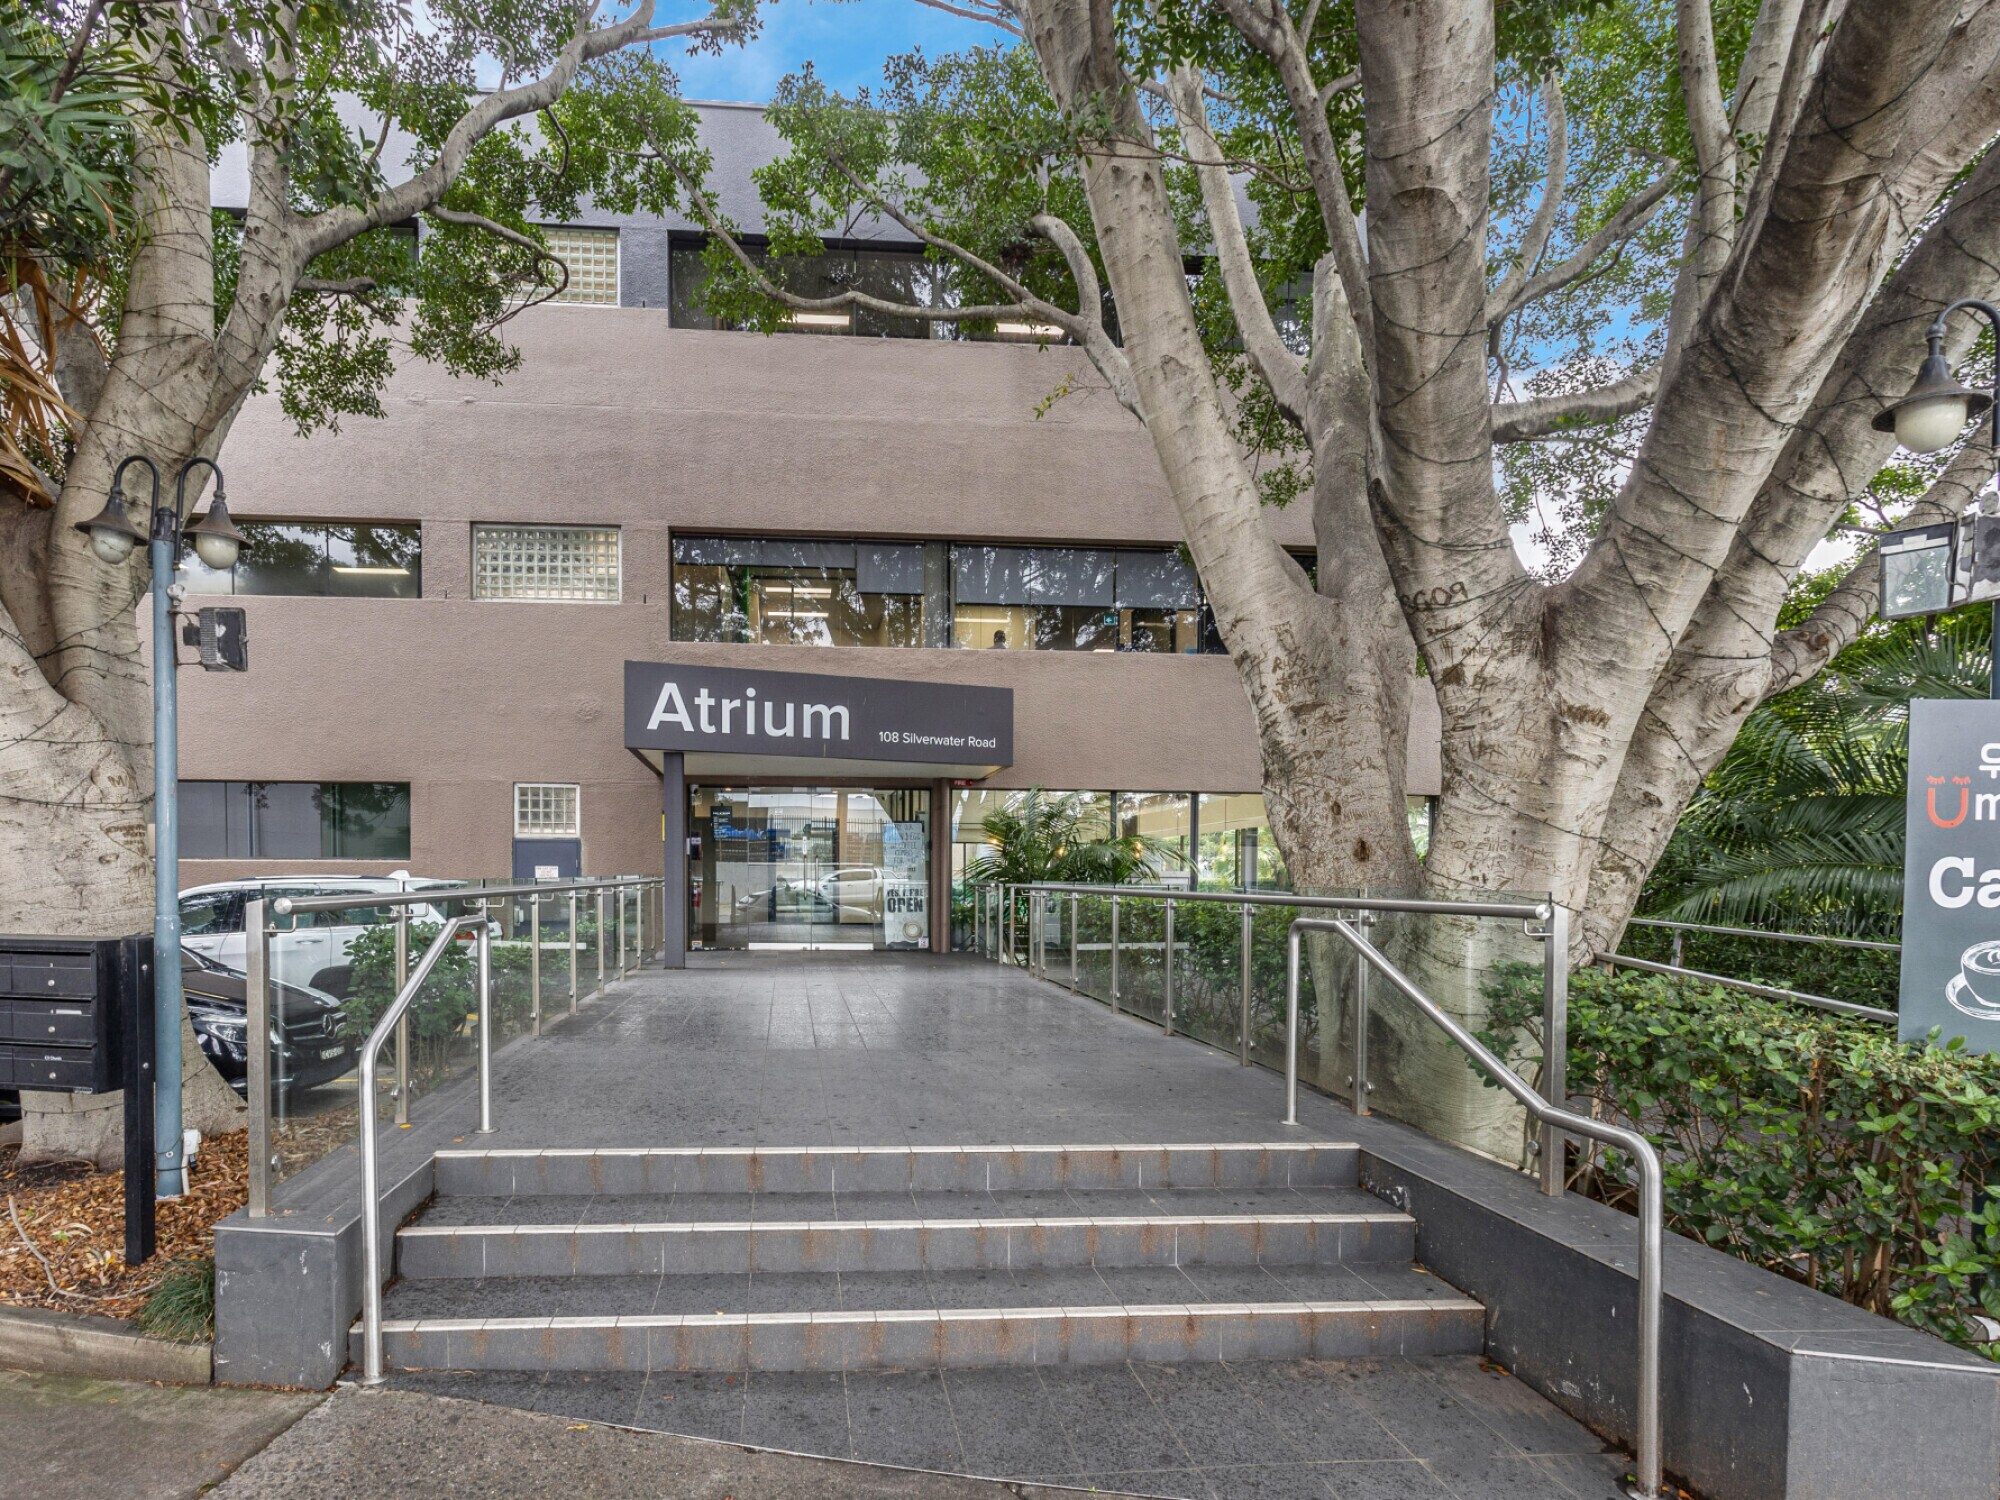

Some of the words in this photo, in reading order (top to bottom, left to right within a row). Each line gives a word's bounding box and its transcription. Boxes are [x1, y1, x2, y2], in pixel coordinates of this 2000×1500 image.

[646, 682, 850, 741] Atrium
[878, 730, 900, 744] 108
[902, 732, 965, 748] Silverwater
[968, 735, 996, 749] Road
[887, 897, 924, 913] OPEN
